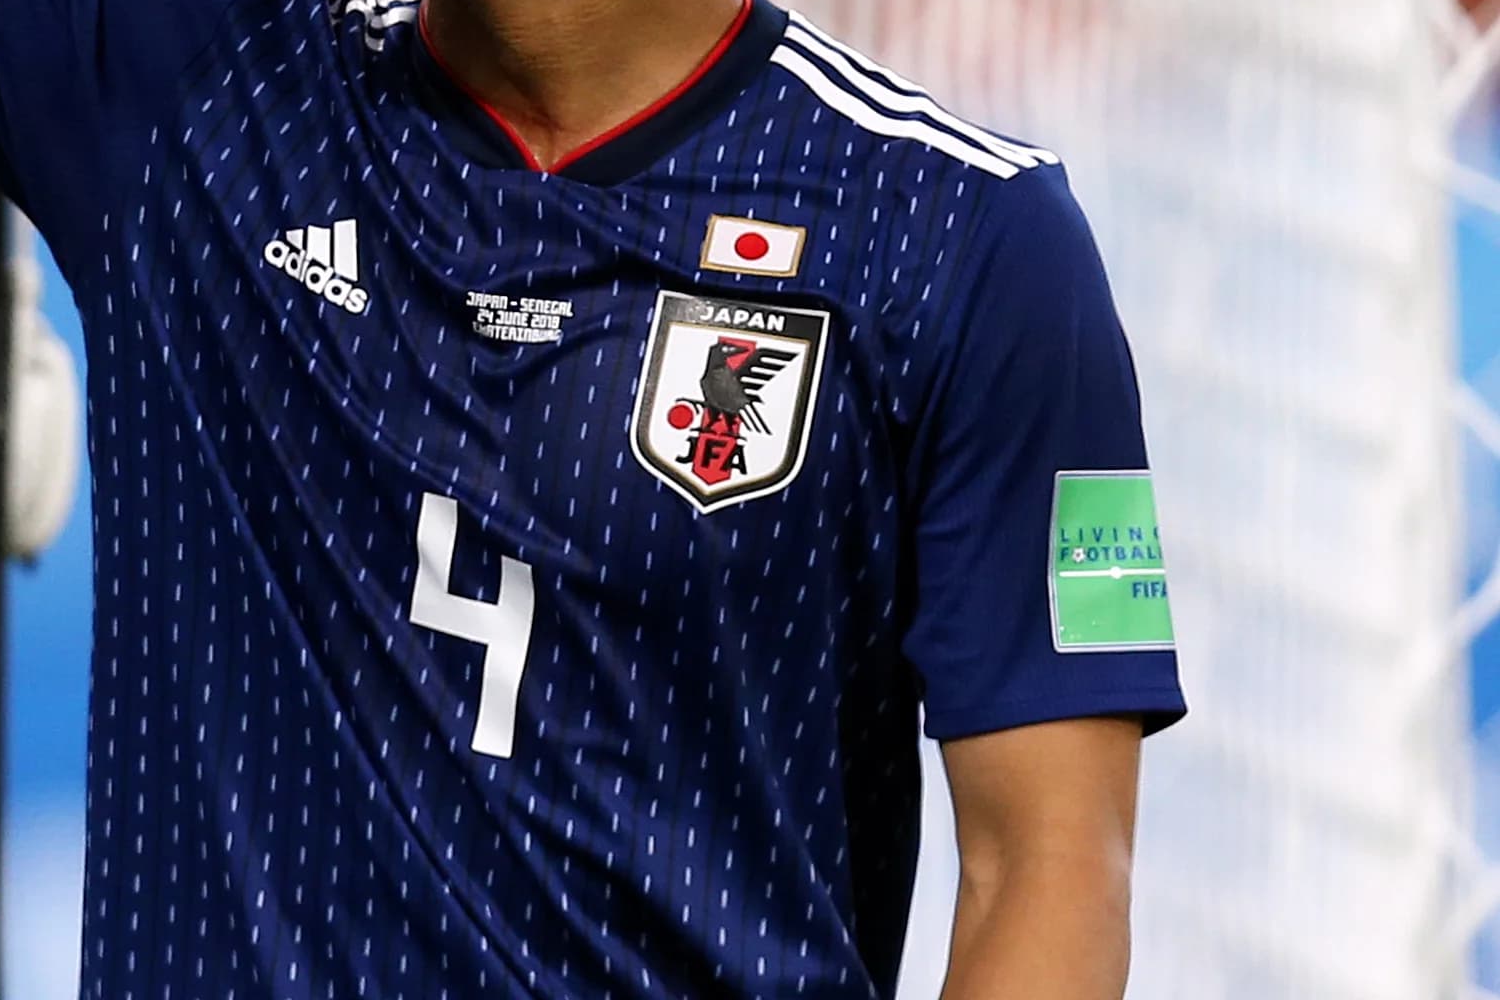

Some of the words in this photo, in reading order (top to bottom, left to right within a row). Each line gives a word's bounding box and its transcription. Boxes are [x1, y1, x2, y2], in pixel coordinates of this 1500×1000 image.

[264, 240, 368, 313] adidas
[466, 291, 508, 310] JAPAN
[519, 297, 574, 317] SENEGAL
[477, 308, 494, 323] 24
[495, 310, 529, 327] JUNE
[700, 305, 785, 332] JAPAN
[675, 436, 747, 475] JFA
[409, 491, 535, 759] 4
